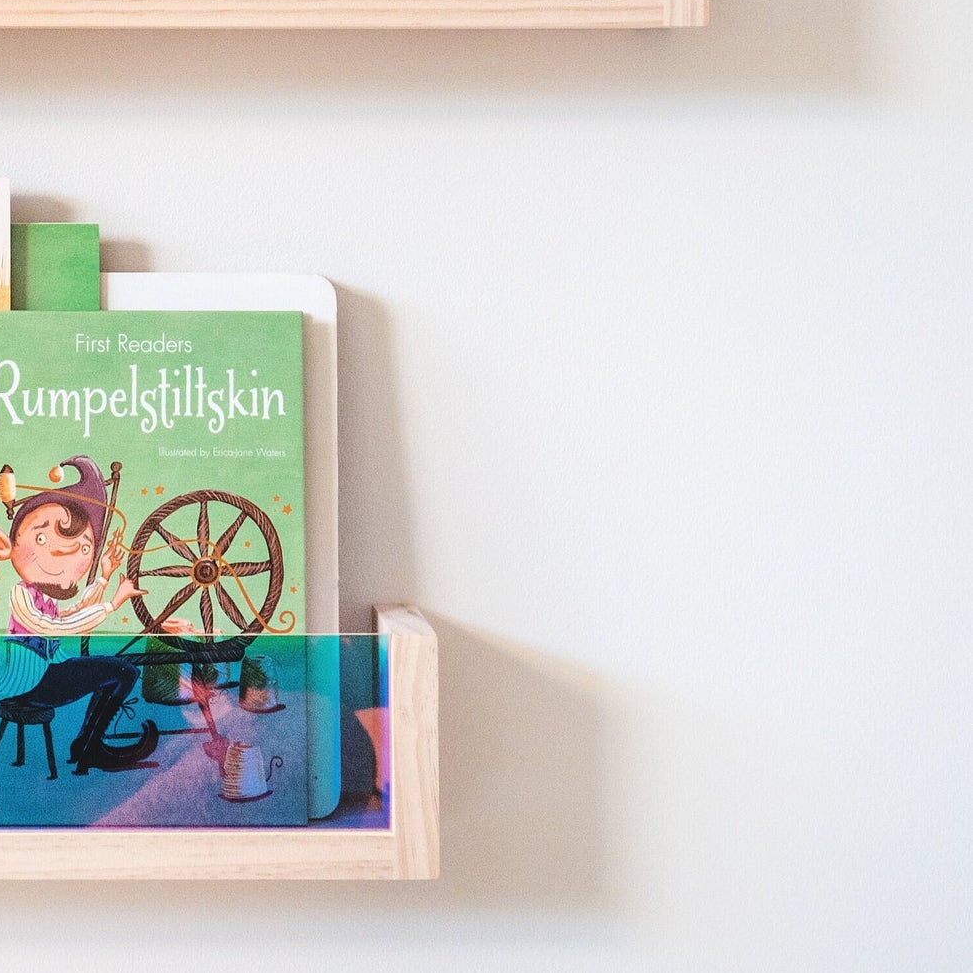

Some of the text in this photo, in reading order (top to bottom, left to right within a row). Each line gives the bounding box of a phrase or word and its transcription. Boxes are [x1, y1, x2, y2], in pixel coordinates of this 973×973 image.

[75, 333, 193, 354] First Readers
[158, 446, 196, 458] Illustrated
[199, 446, 210, 460] by
[256, 447, 287, 458] Waters
